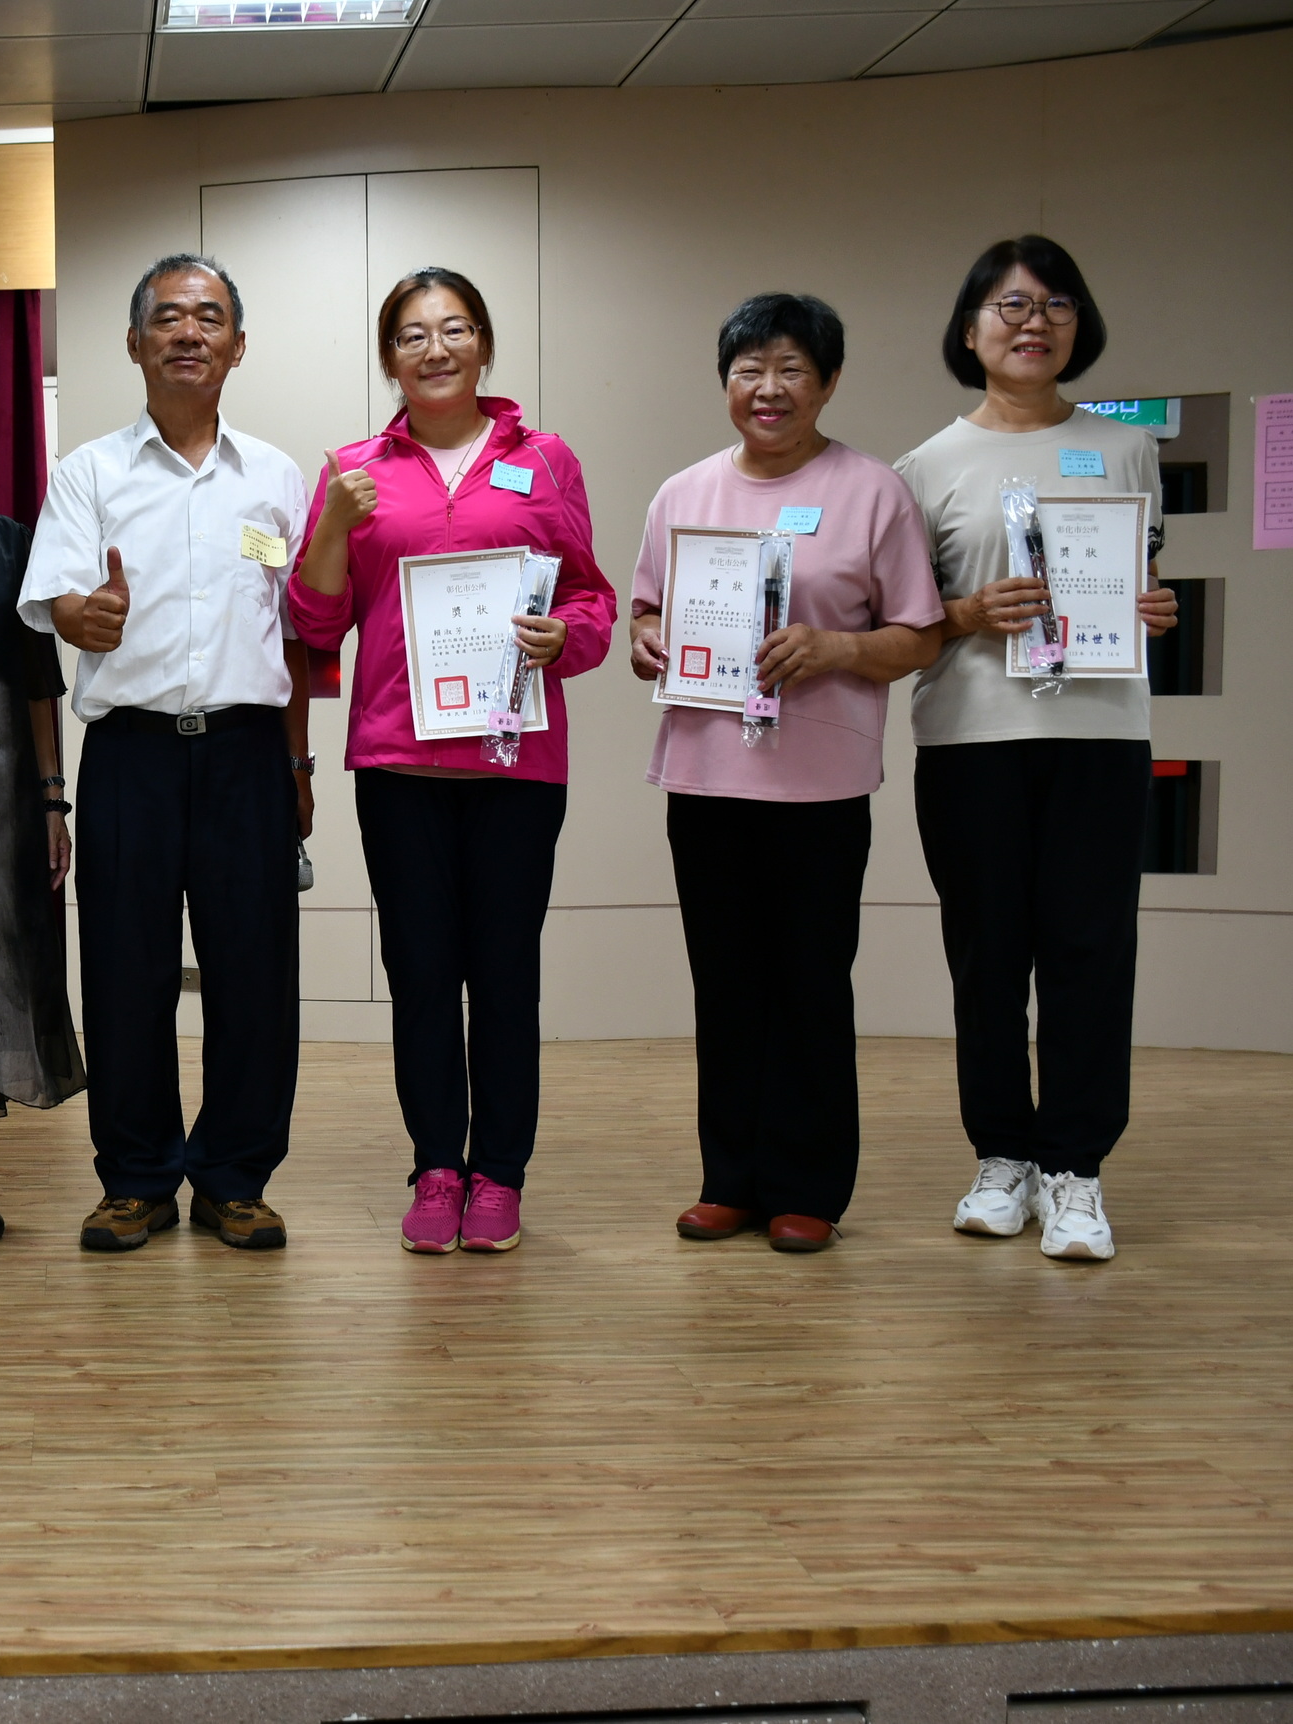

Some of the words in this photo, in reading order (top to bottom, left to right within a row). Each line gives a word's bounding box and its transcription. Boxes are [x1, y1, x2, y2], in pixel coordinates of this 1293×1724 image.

[709, 557, 748, 568] 彰化市公所
[446, 582, 487, 594] 彰化市公所
[1075, 632, 1120, 645] 林世賢
[717, 664, 748, 677] 林世
